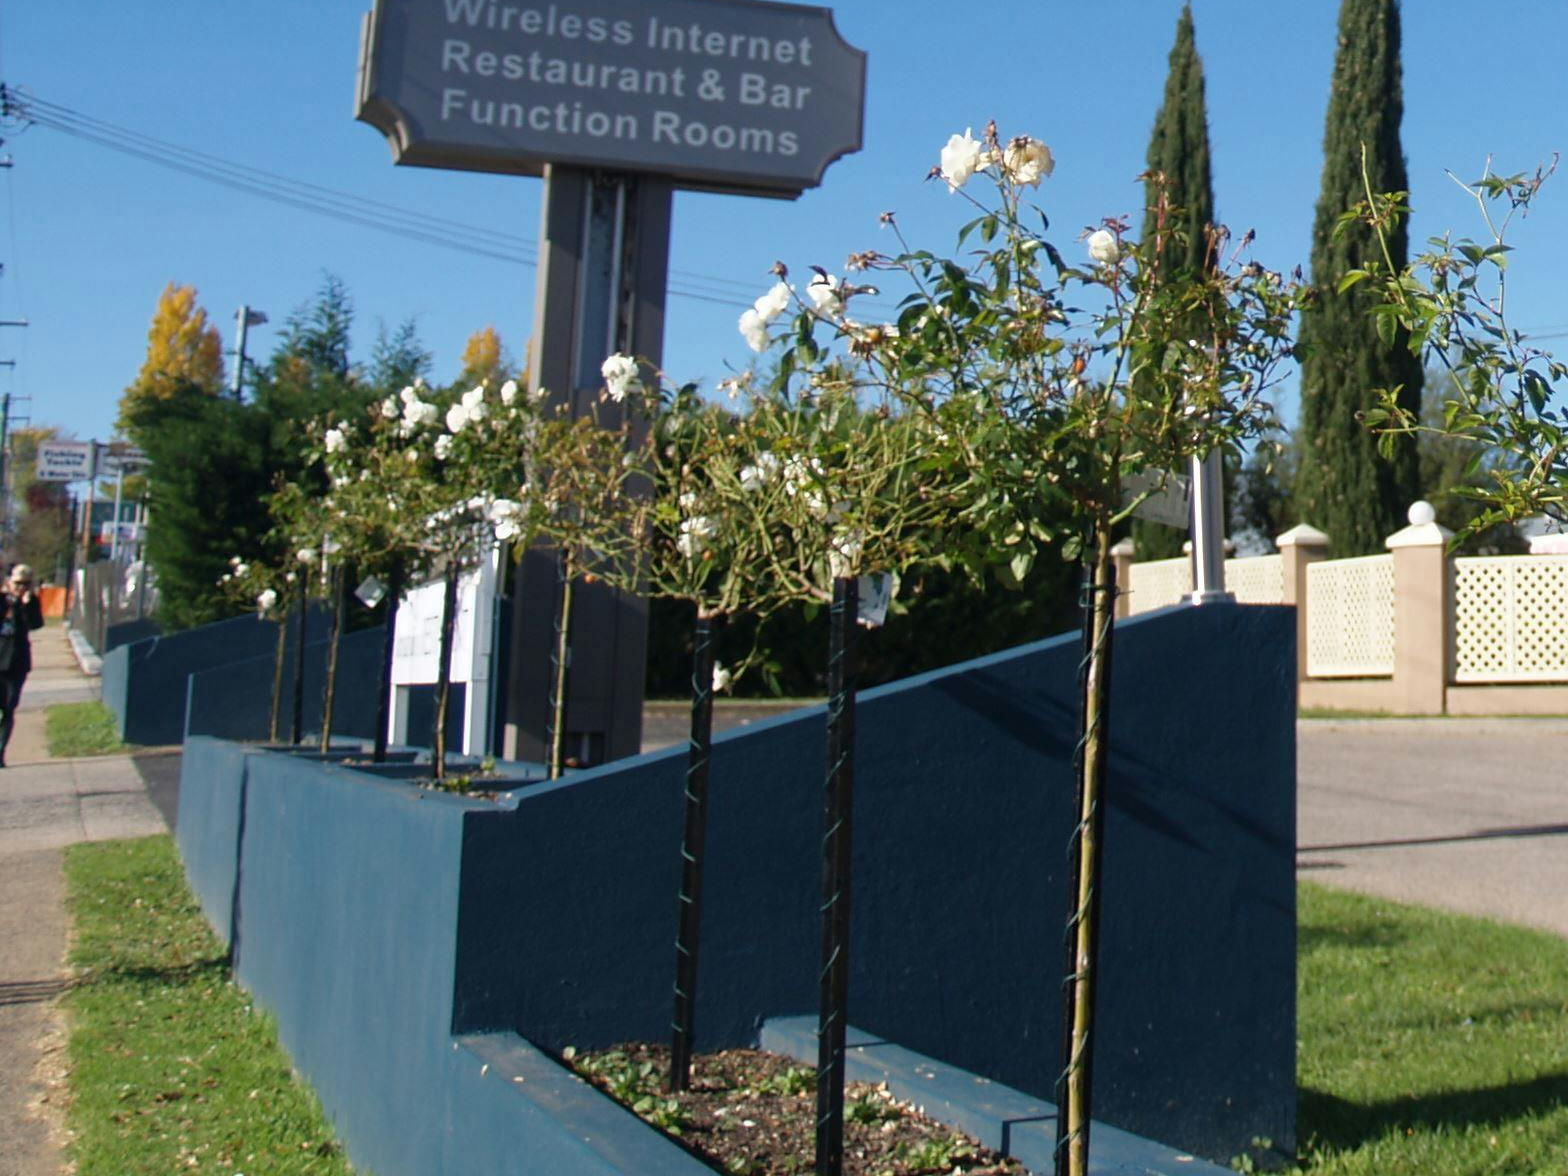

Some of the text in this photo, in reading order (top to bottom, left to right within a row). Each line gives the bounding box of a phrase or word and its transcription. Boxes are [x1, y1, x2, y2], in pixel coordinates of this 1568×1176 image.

[441, 39, 811, 110] Restaurant & Bar
[648, 17, 812, 66] Internet
[440, 89, 799, 156] Function Rooms
